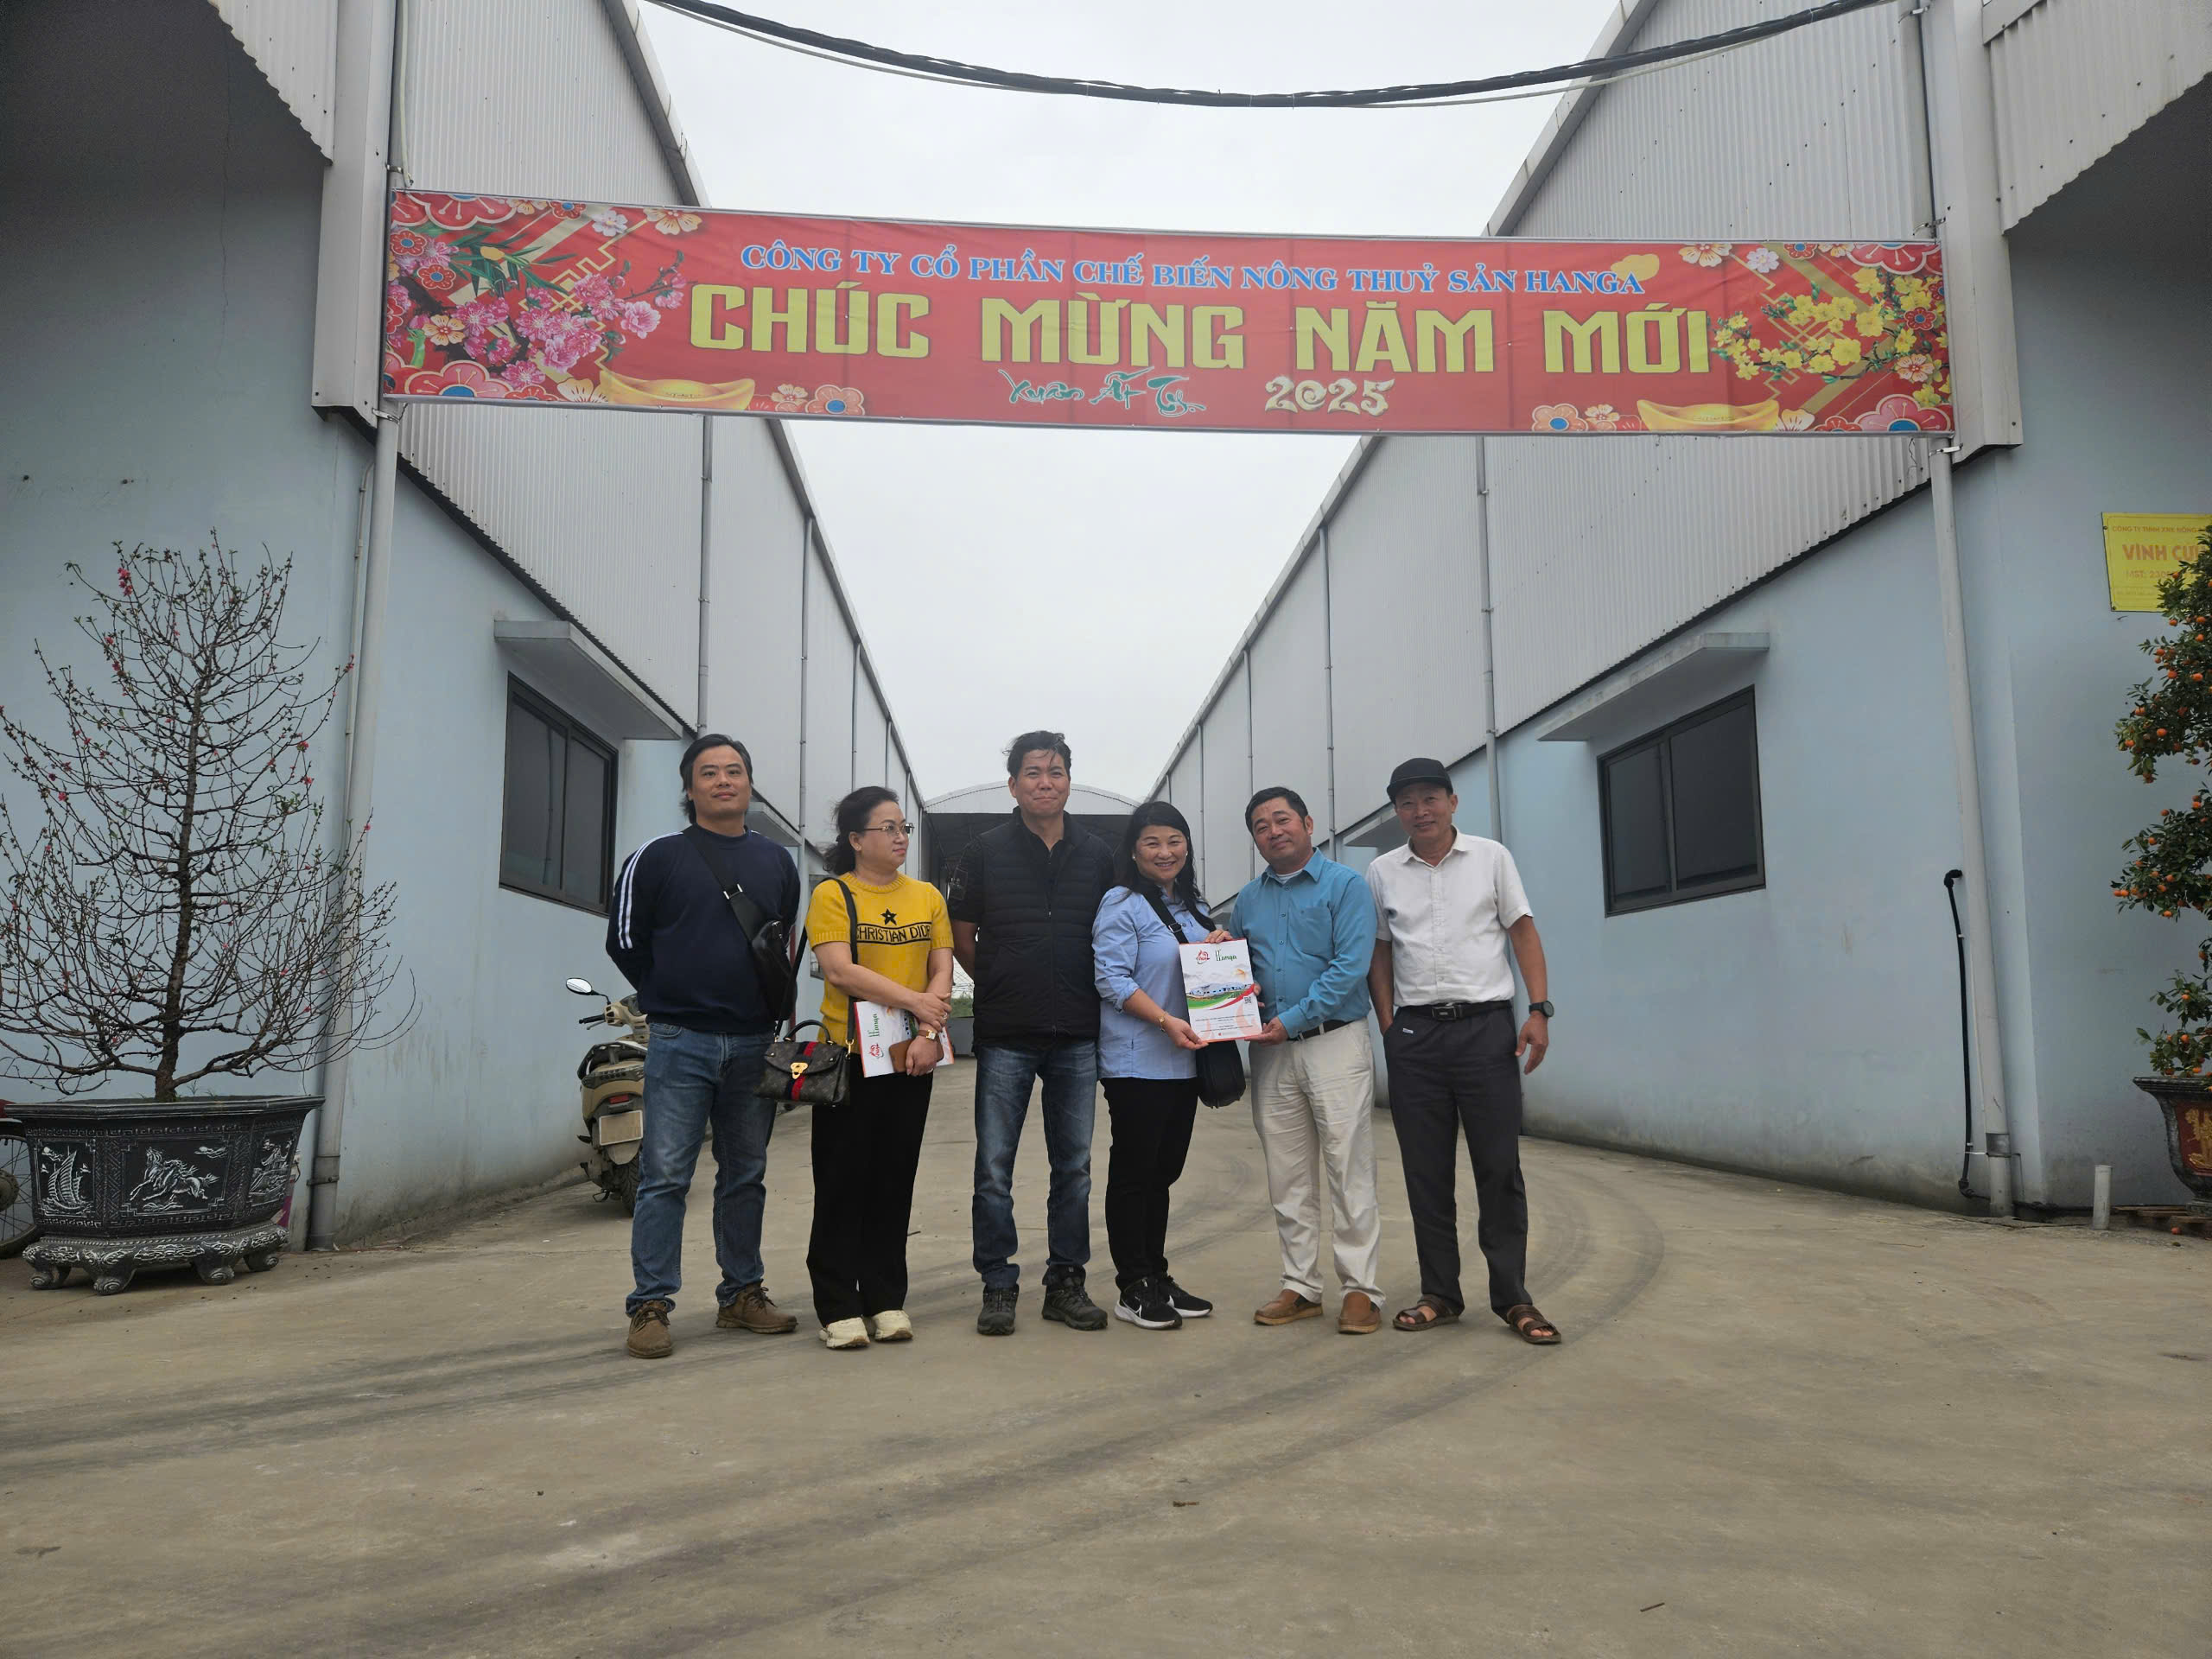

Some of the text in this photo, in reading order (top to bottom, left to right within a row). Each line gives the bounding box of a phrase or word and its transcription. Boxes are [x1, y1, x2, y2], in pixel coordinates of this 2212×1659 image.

[741, 240, 1643, 294] CÔNG TY CỔ PHẦN CHẾ BIẾN NÔNG THUỶ SẢN HANGA
[690, 282, 1711, 374] CHÚC MỪNG NĂM MỚI
[1265, 376, 1395, 416] 2025
